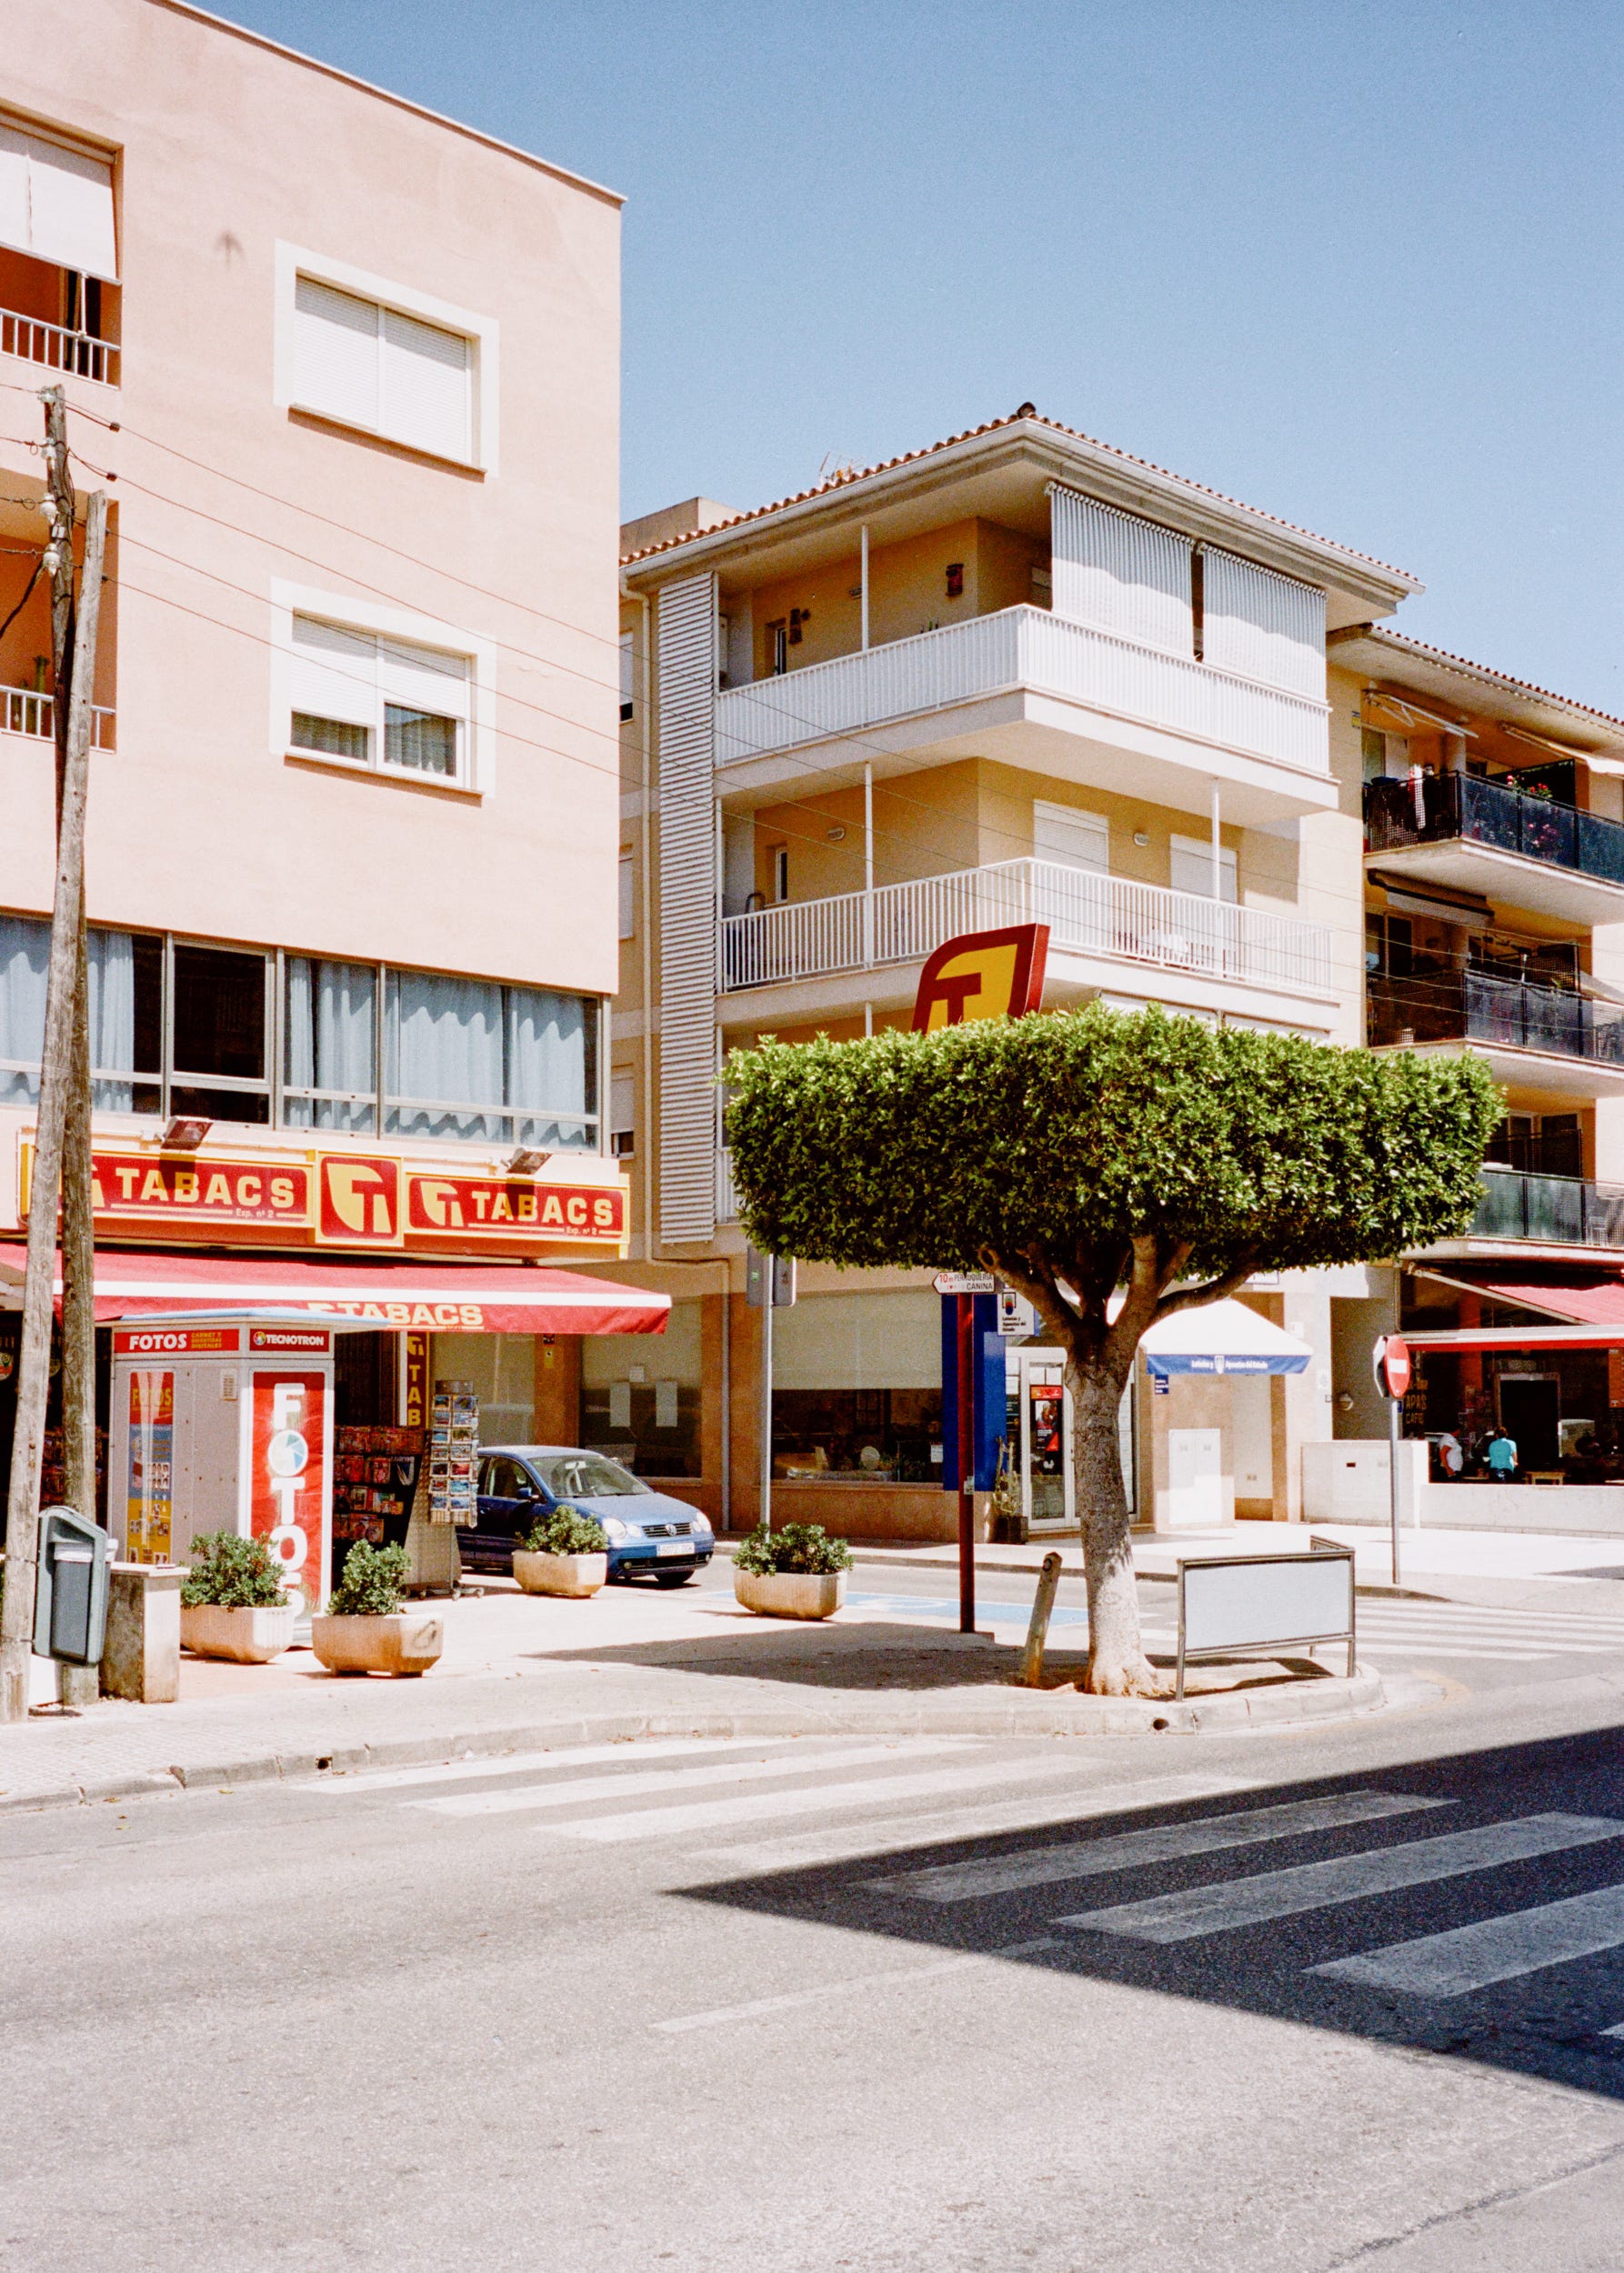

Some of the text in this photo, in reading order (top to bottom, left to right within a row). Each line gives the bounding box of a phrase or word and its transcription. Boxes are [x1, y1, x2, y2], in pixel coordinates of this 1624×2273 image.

[115, 1167, 295, 1208] TABACS
[471, 1191, 614, 1227] TABACS
[967, 1280, 993, 1290] CANINA
[337, 1303, 484, 1326] TABACS
[129, 1334, 187, 1351] FOTOS
[266, 1334, 325, 1347] TECNOTRON
[268, 1383, 309, 1617] FOTOS
